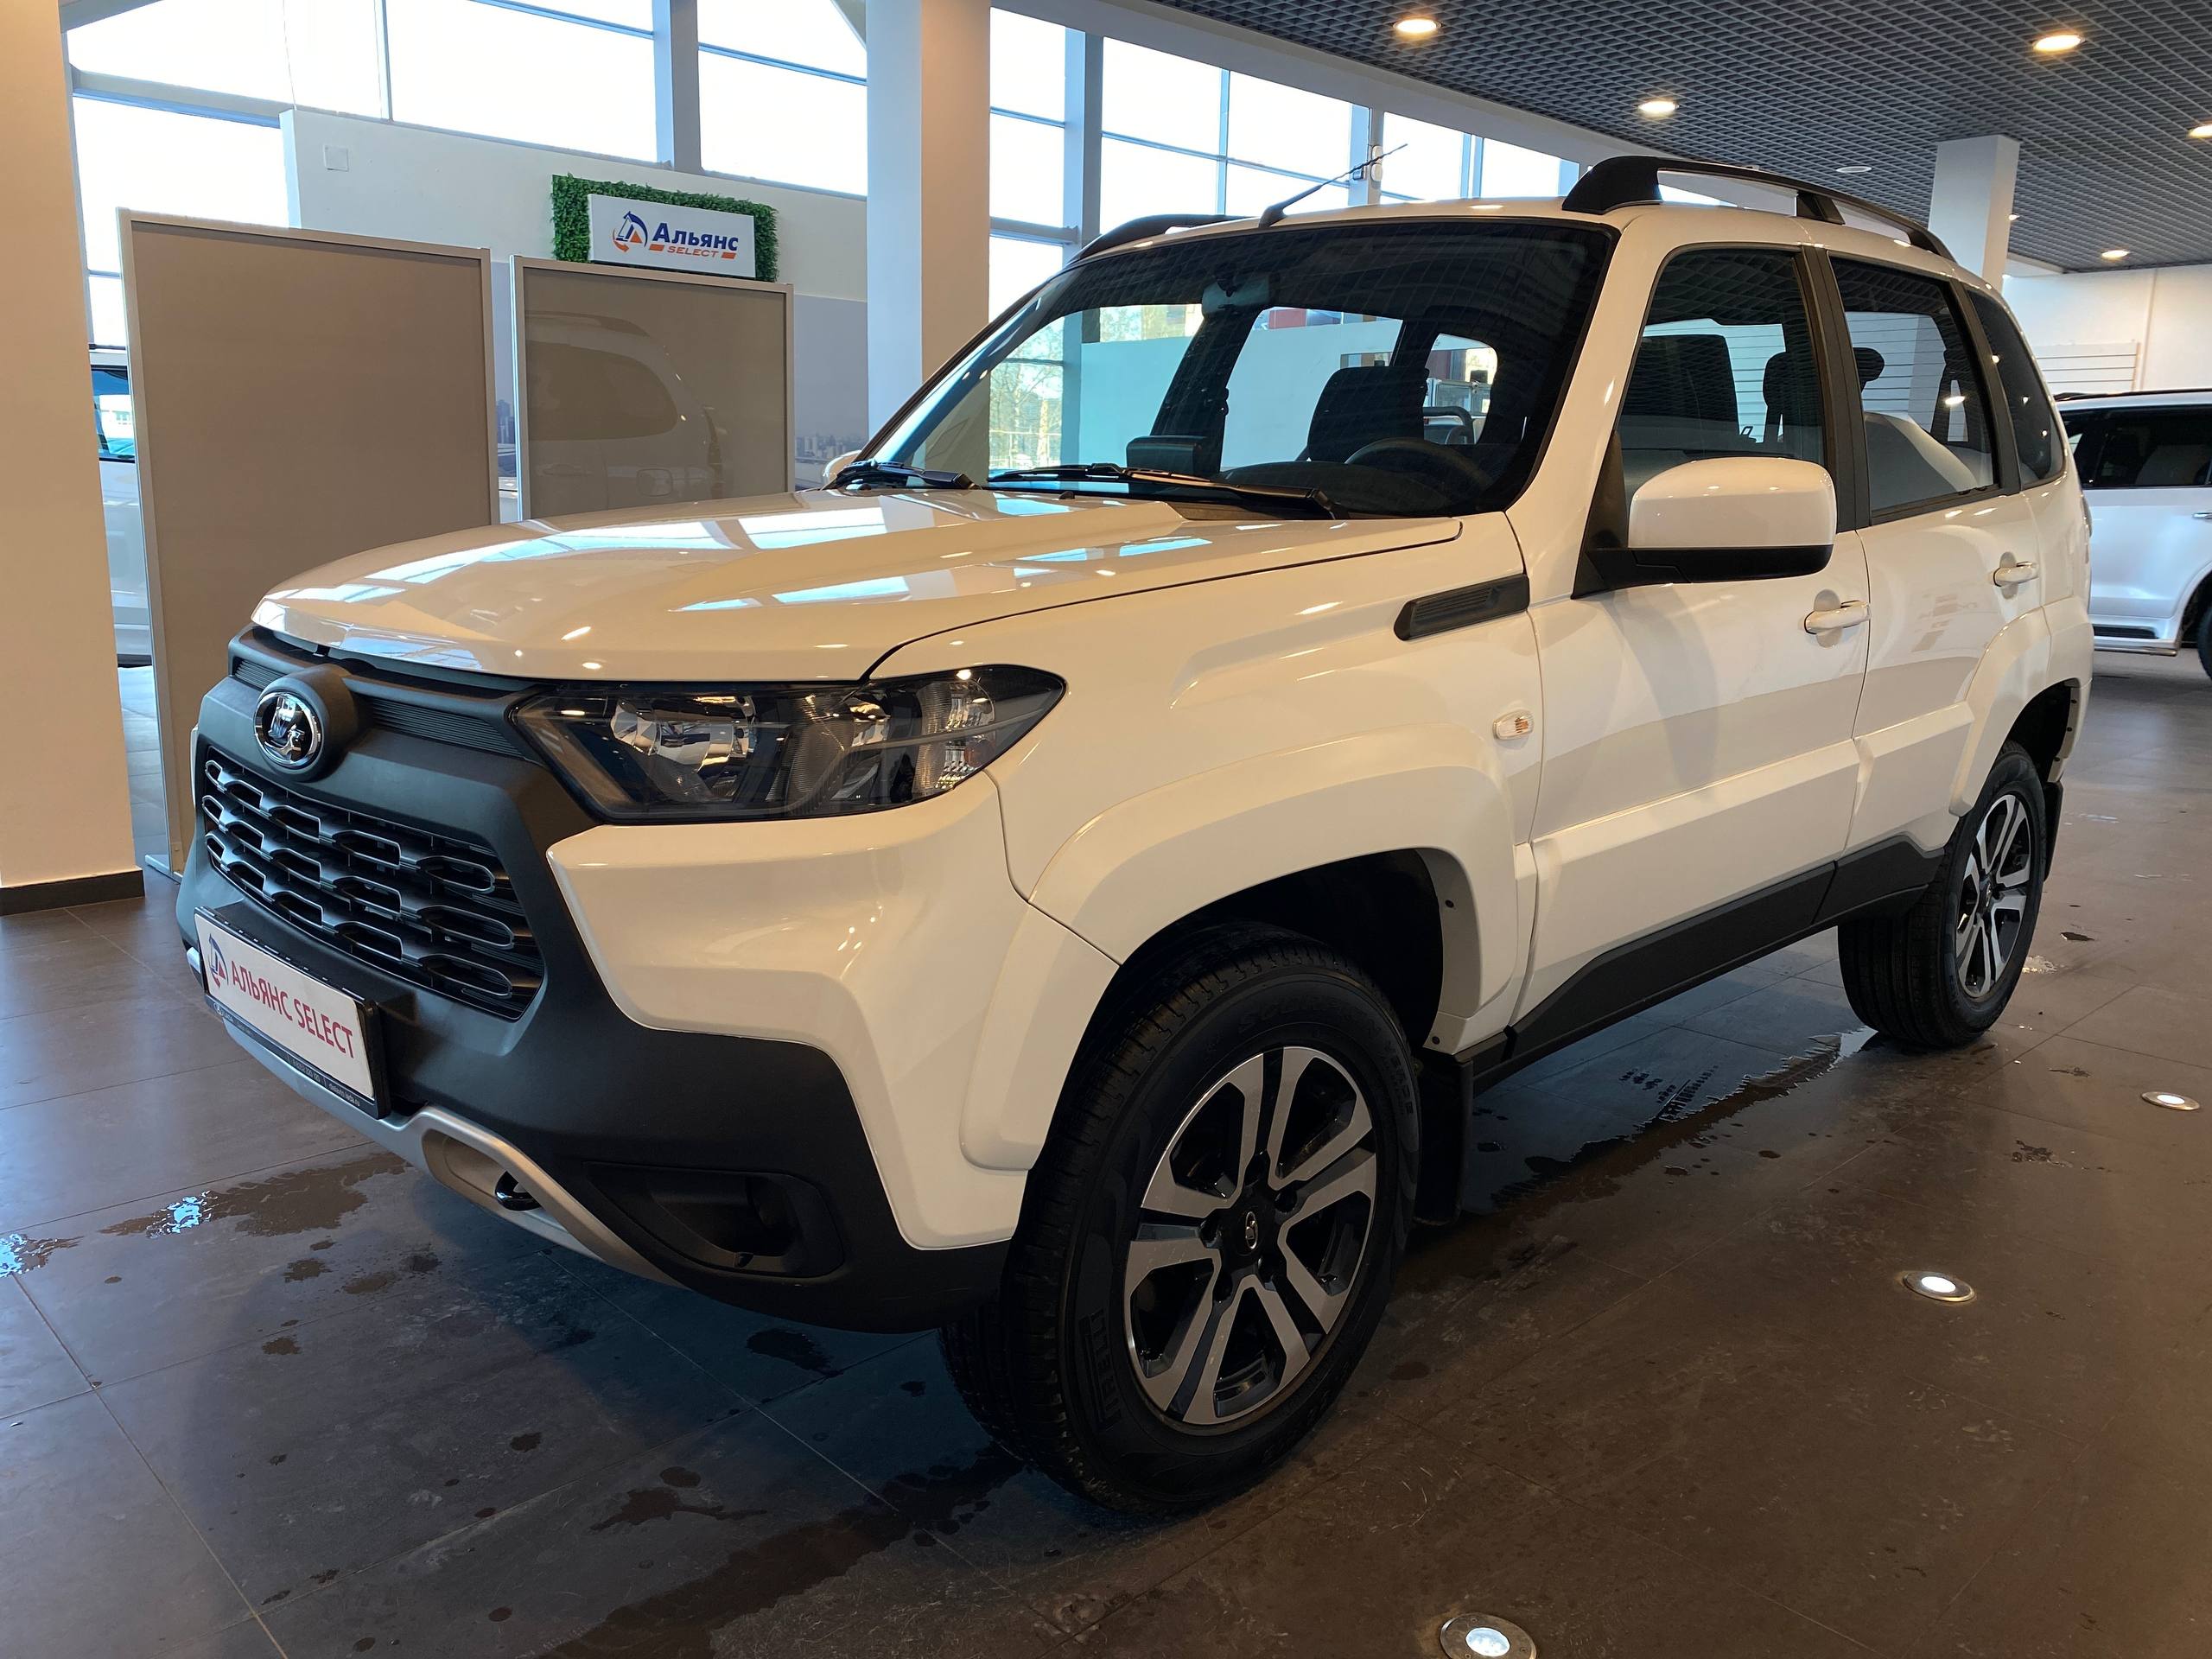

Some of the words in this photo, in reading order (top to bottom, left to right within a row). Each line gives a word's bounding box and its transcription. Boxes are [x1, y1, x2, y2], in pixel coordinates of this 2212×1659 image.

[667, 245, 719, 257] SELECT
[231, 960, 293, 1021] АЛЬЯНС
[294, 998, 354, 1058] SELECT
